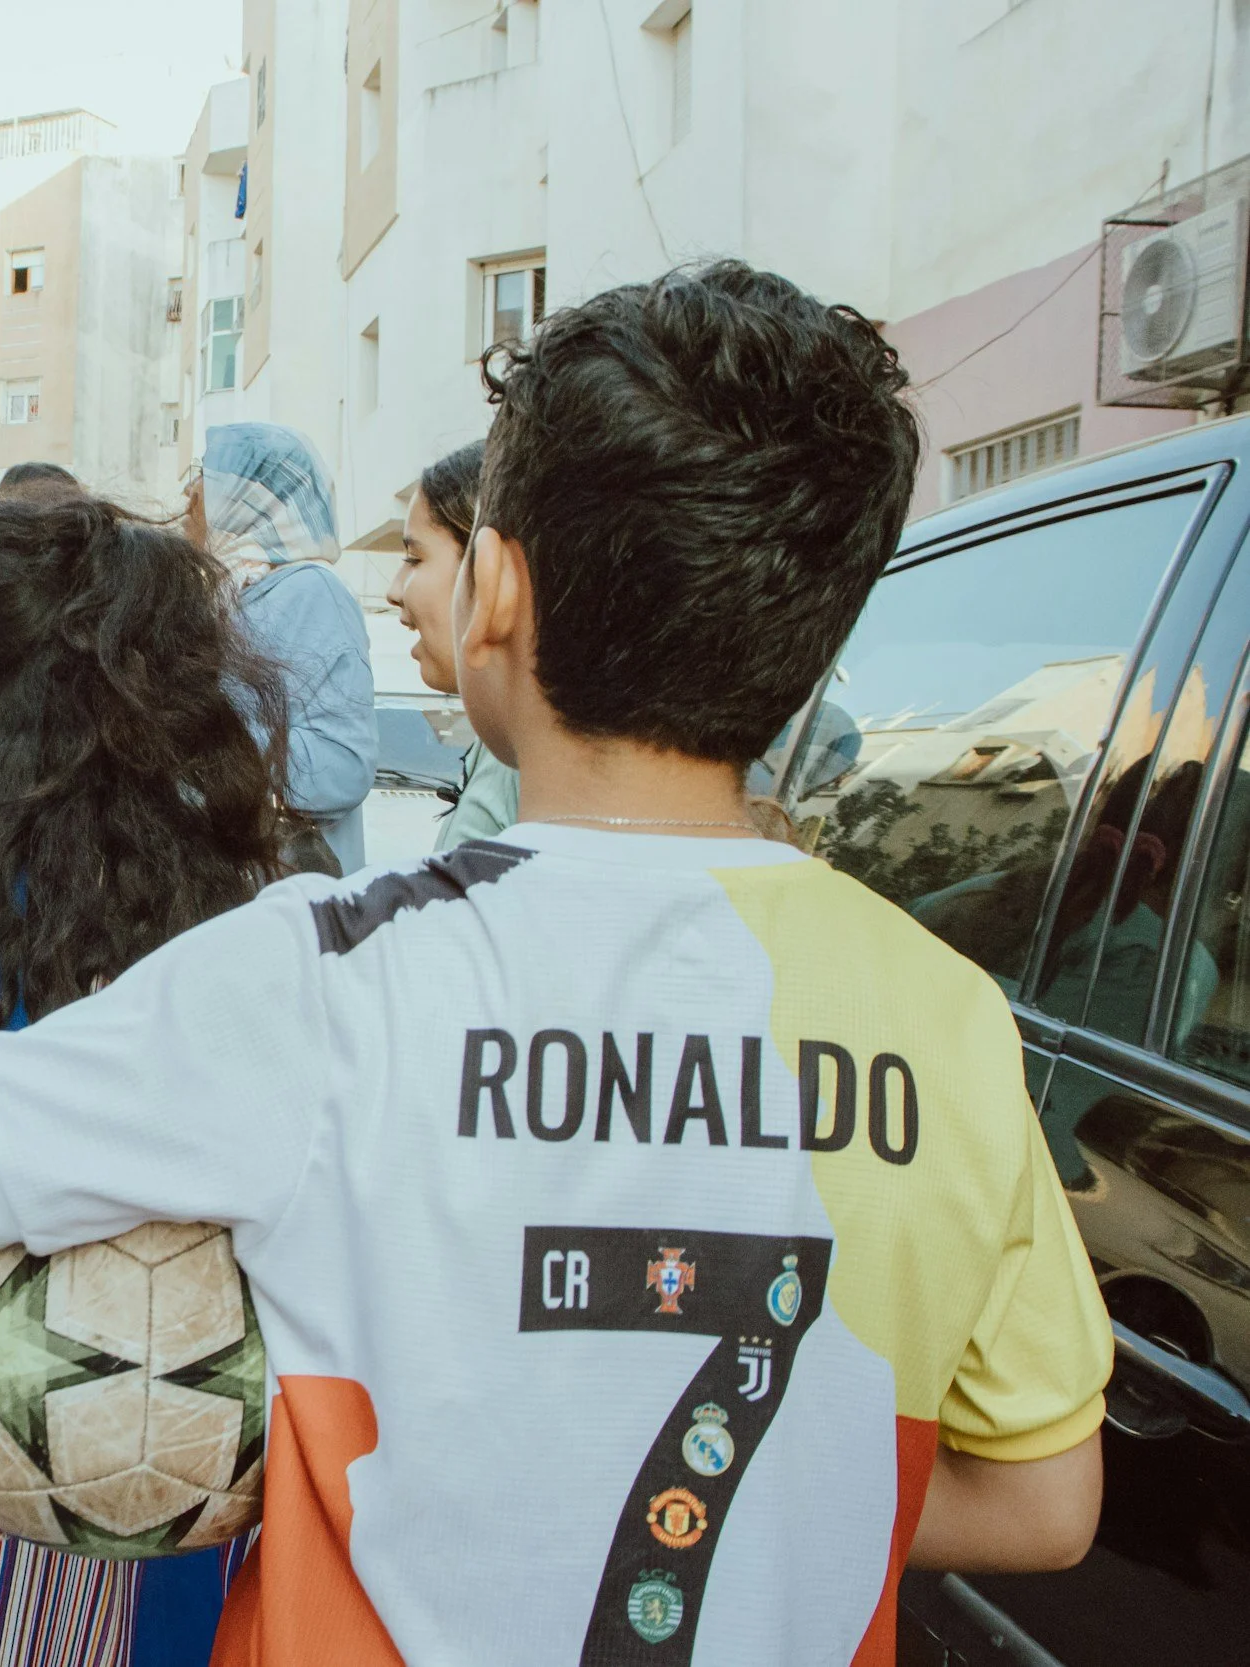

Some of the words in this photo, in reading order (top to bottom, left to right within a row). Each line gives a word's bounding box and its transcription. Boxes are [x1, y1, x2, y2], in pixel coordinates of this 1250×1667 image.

[457, 1028, 919, 1165] RONALDO
[542, 1250, 590, 1310] CR
[518, 1226, 834, 1667] 7
